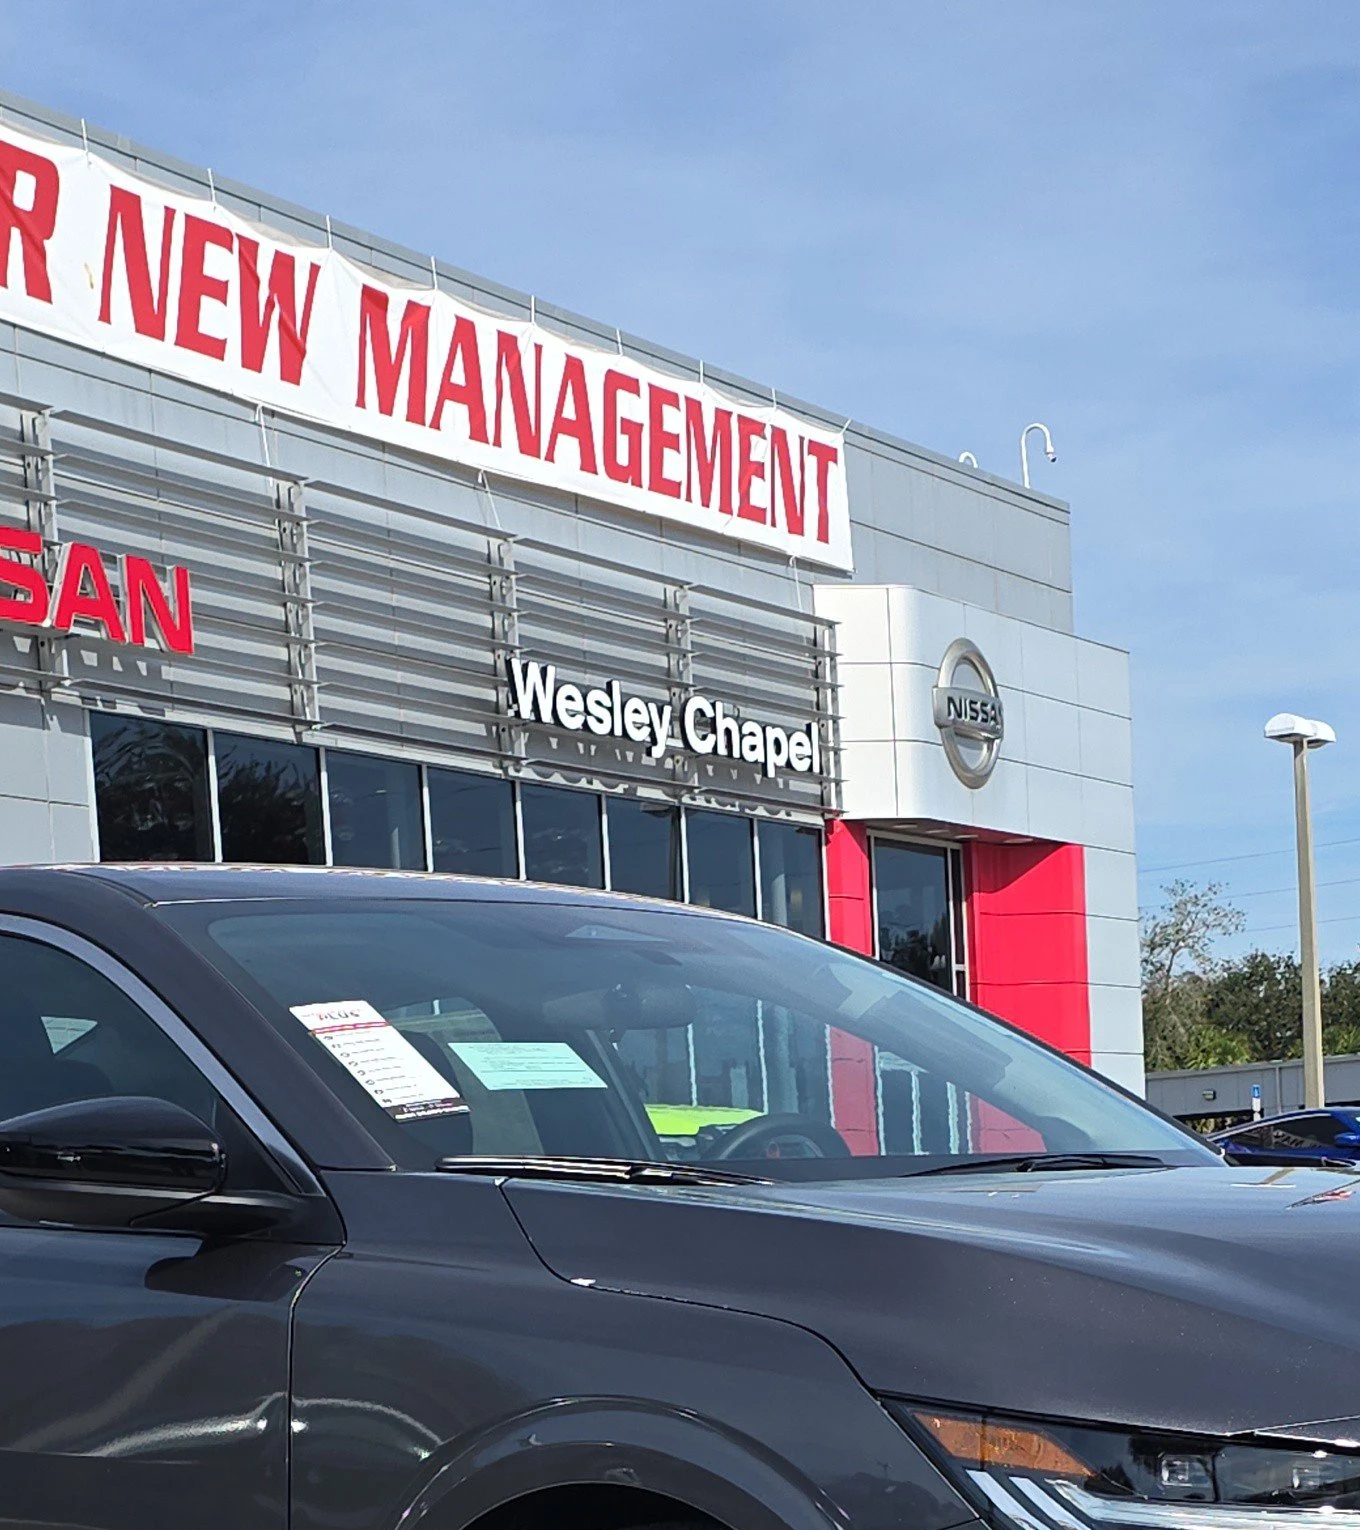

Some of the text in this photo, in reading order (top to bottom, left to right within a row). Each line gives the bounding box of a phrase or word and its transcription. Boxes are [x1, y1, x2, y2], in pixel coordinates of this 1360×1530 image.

[98, 185, 320, 387] NEW
[355, 285, 839, 544] MANAGEMENT
[507, 657, 821, 779] Wesley Chapel
